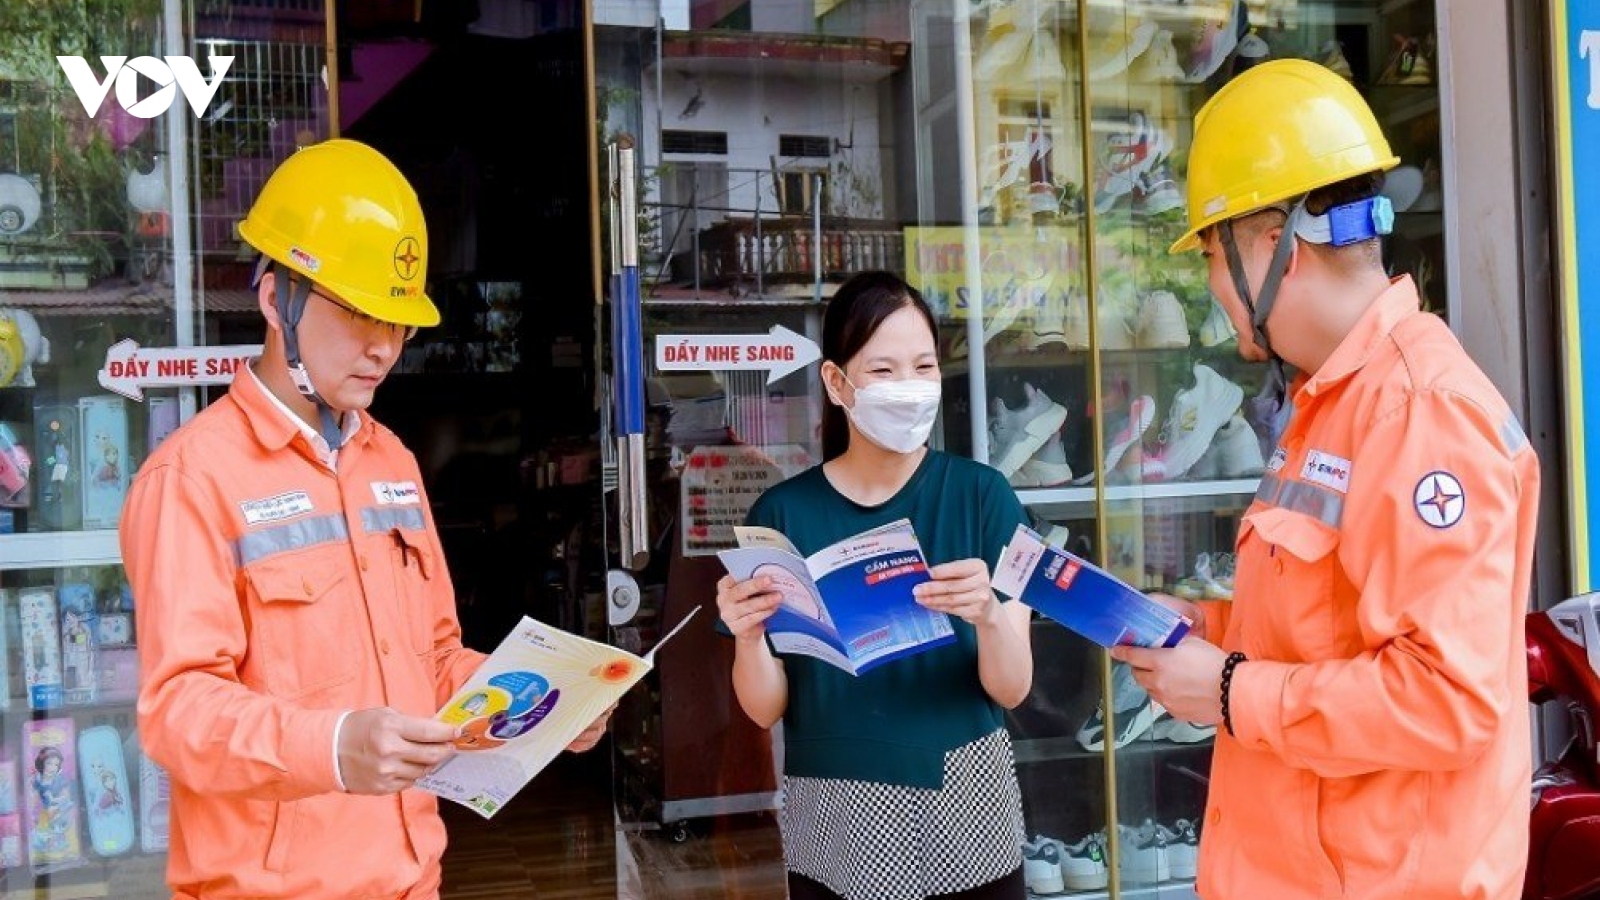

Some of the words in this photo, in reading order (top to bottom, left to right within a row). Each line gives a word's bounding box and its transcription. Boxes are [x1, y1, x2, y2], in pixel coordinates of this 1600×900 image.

[704, 345, 741, 364] NHẸ
[746, 345, 795, 361] SANG
[157, 359, 198, 378] NHẸ
